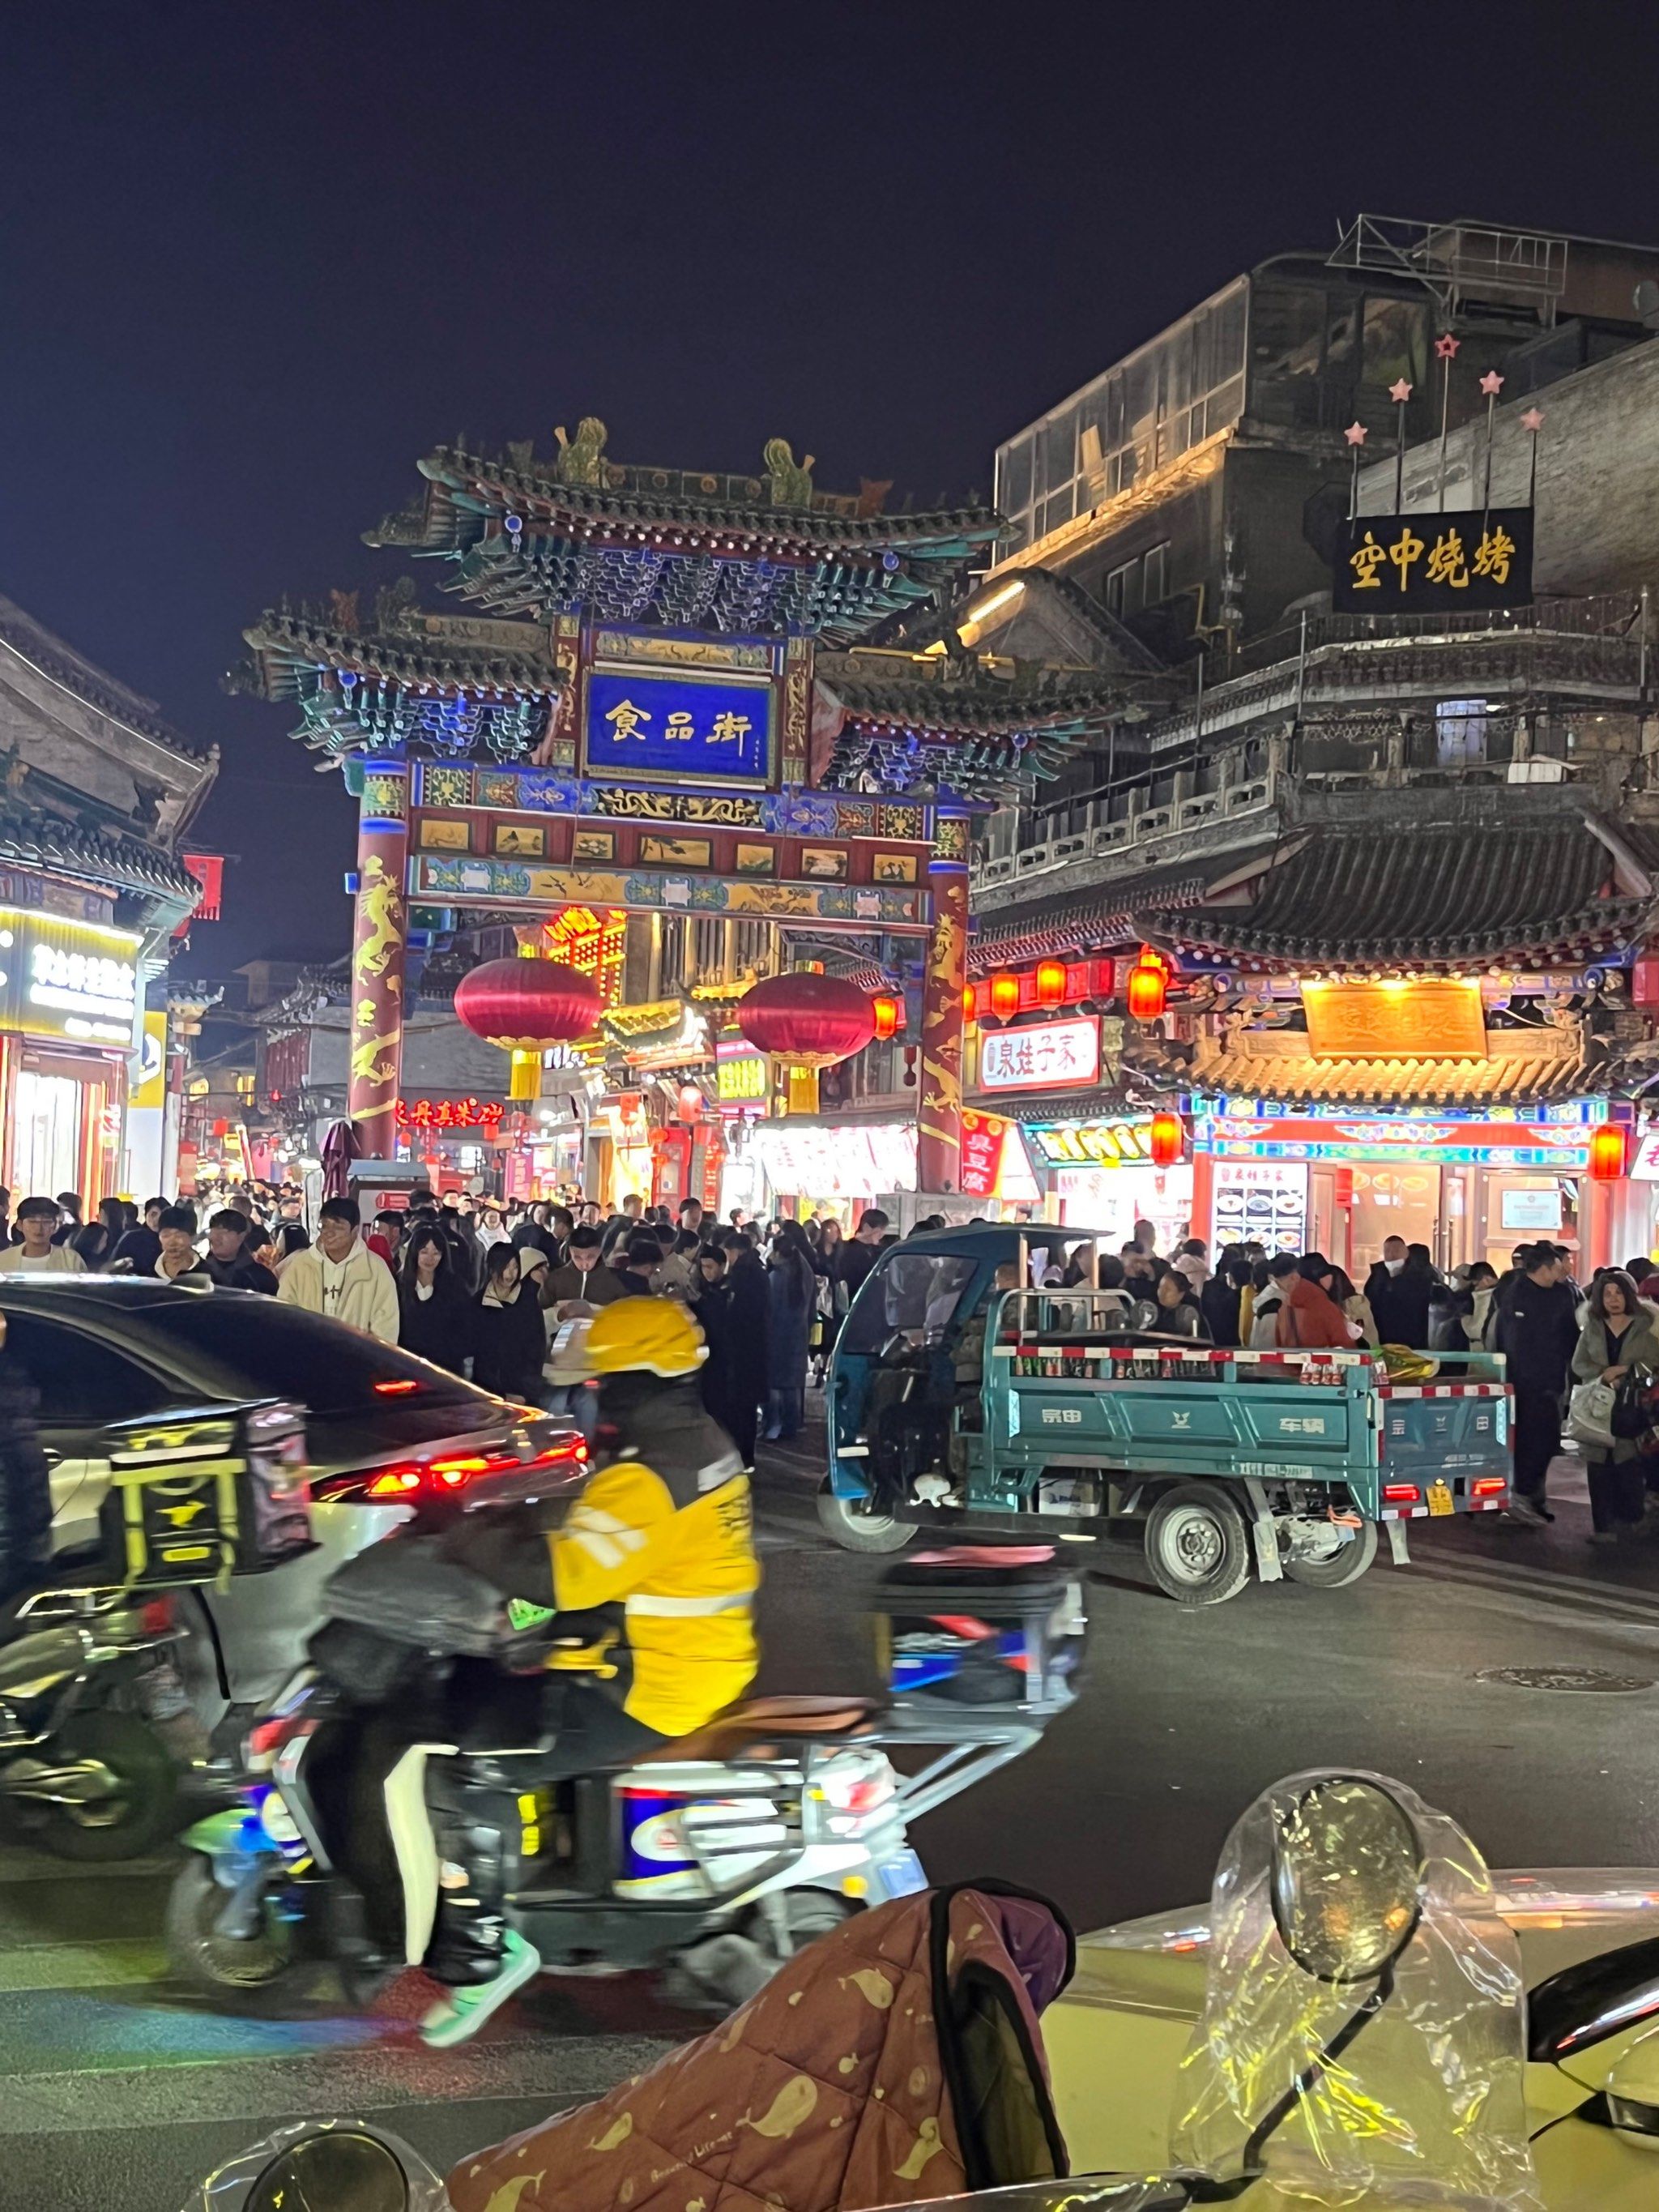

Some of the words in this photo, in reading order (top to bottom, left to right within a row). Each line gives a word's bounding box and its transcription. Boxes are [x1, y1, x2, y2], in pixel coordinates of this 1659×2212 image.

[1349, 525, 1516, 592] 空中烧烤
[605, 698, 753, 758] 食品街
[996, 1034, 1076, 1078] 泉娃子家
